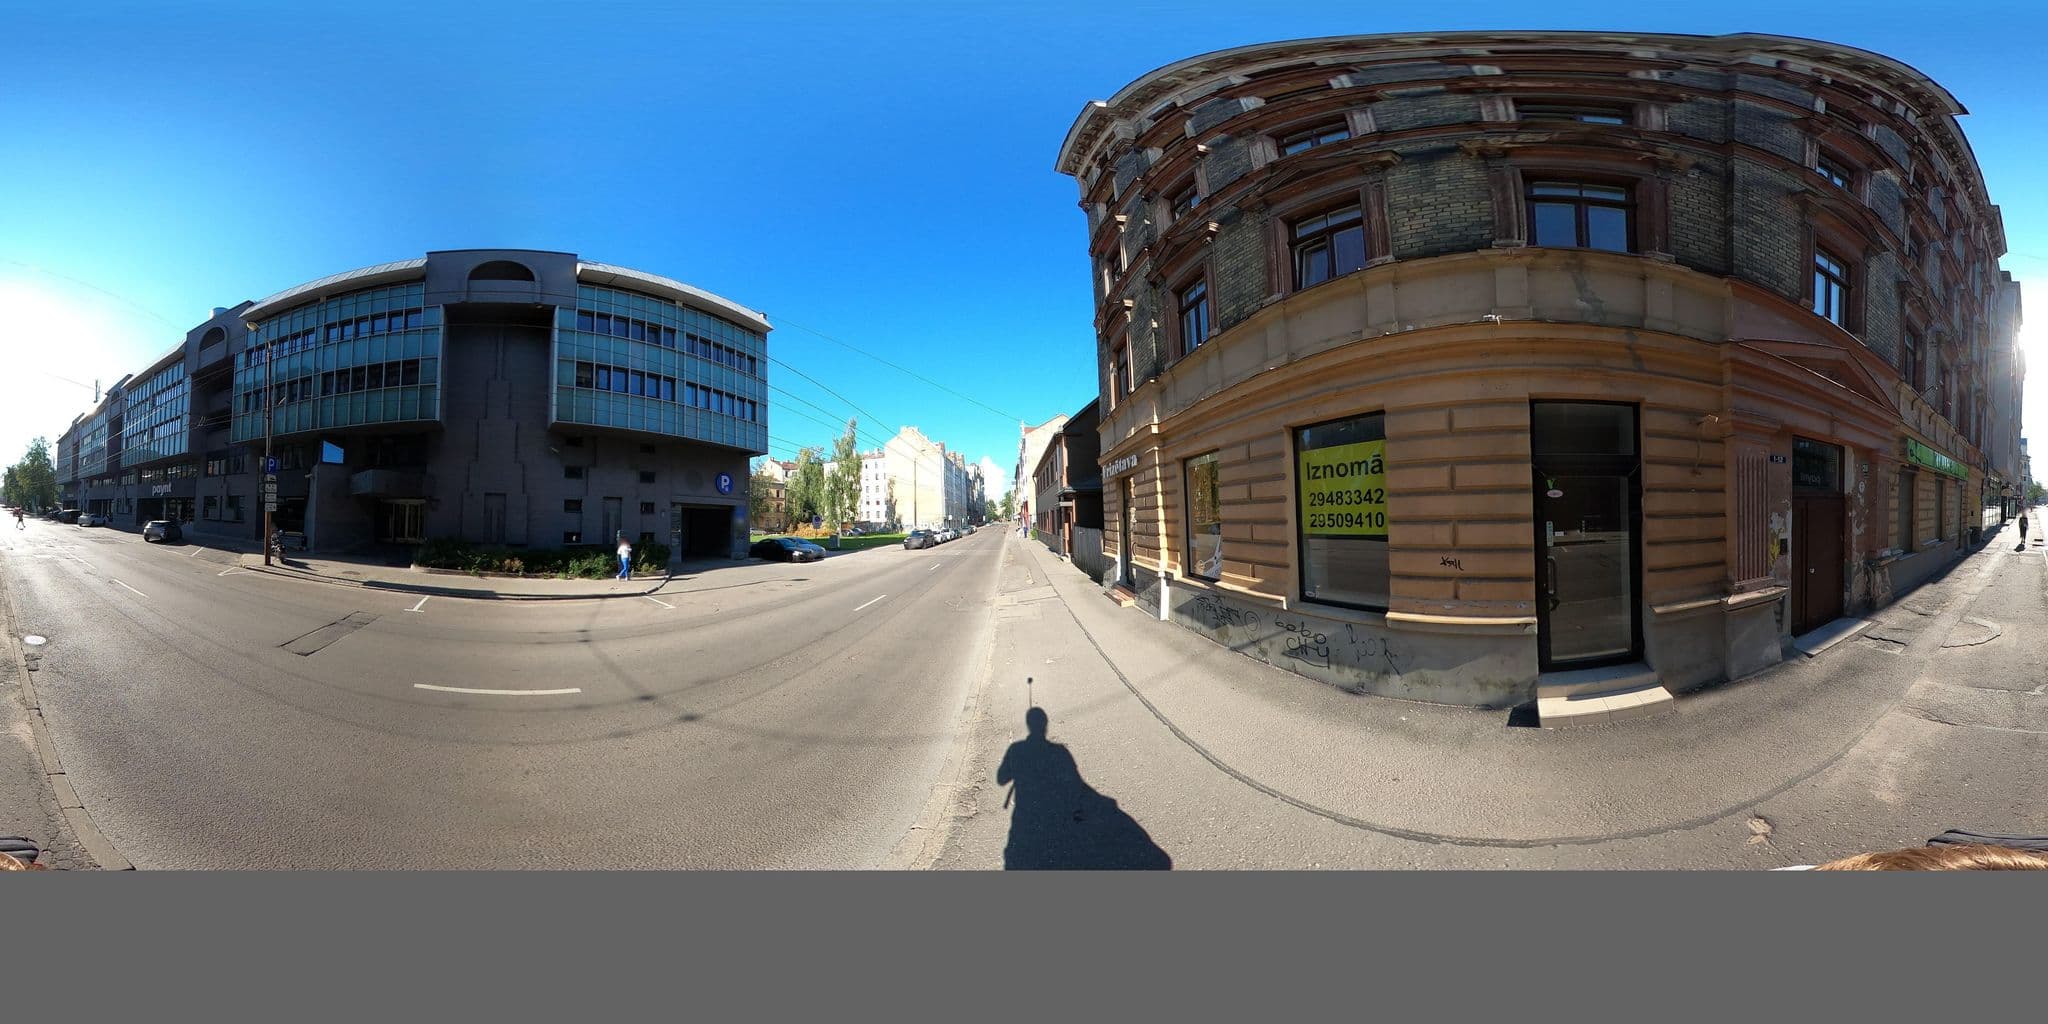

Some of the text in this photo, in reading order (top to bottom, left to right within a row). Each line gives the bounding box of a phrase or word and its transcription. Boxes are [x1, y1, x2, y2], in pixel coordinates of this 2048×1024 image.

[268, 458, 275, 472] P
[1306, 453, 1384, 481] Iznomā
[152, 481, 172, 496] paynt
[721, 475, 730, 489] P
[1309, 488, 1384, 507] 29483342
[1309, 511, 1384, 529] 29509410
